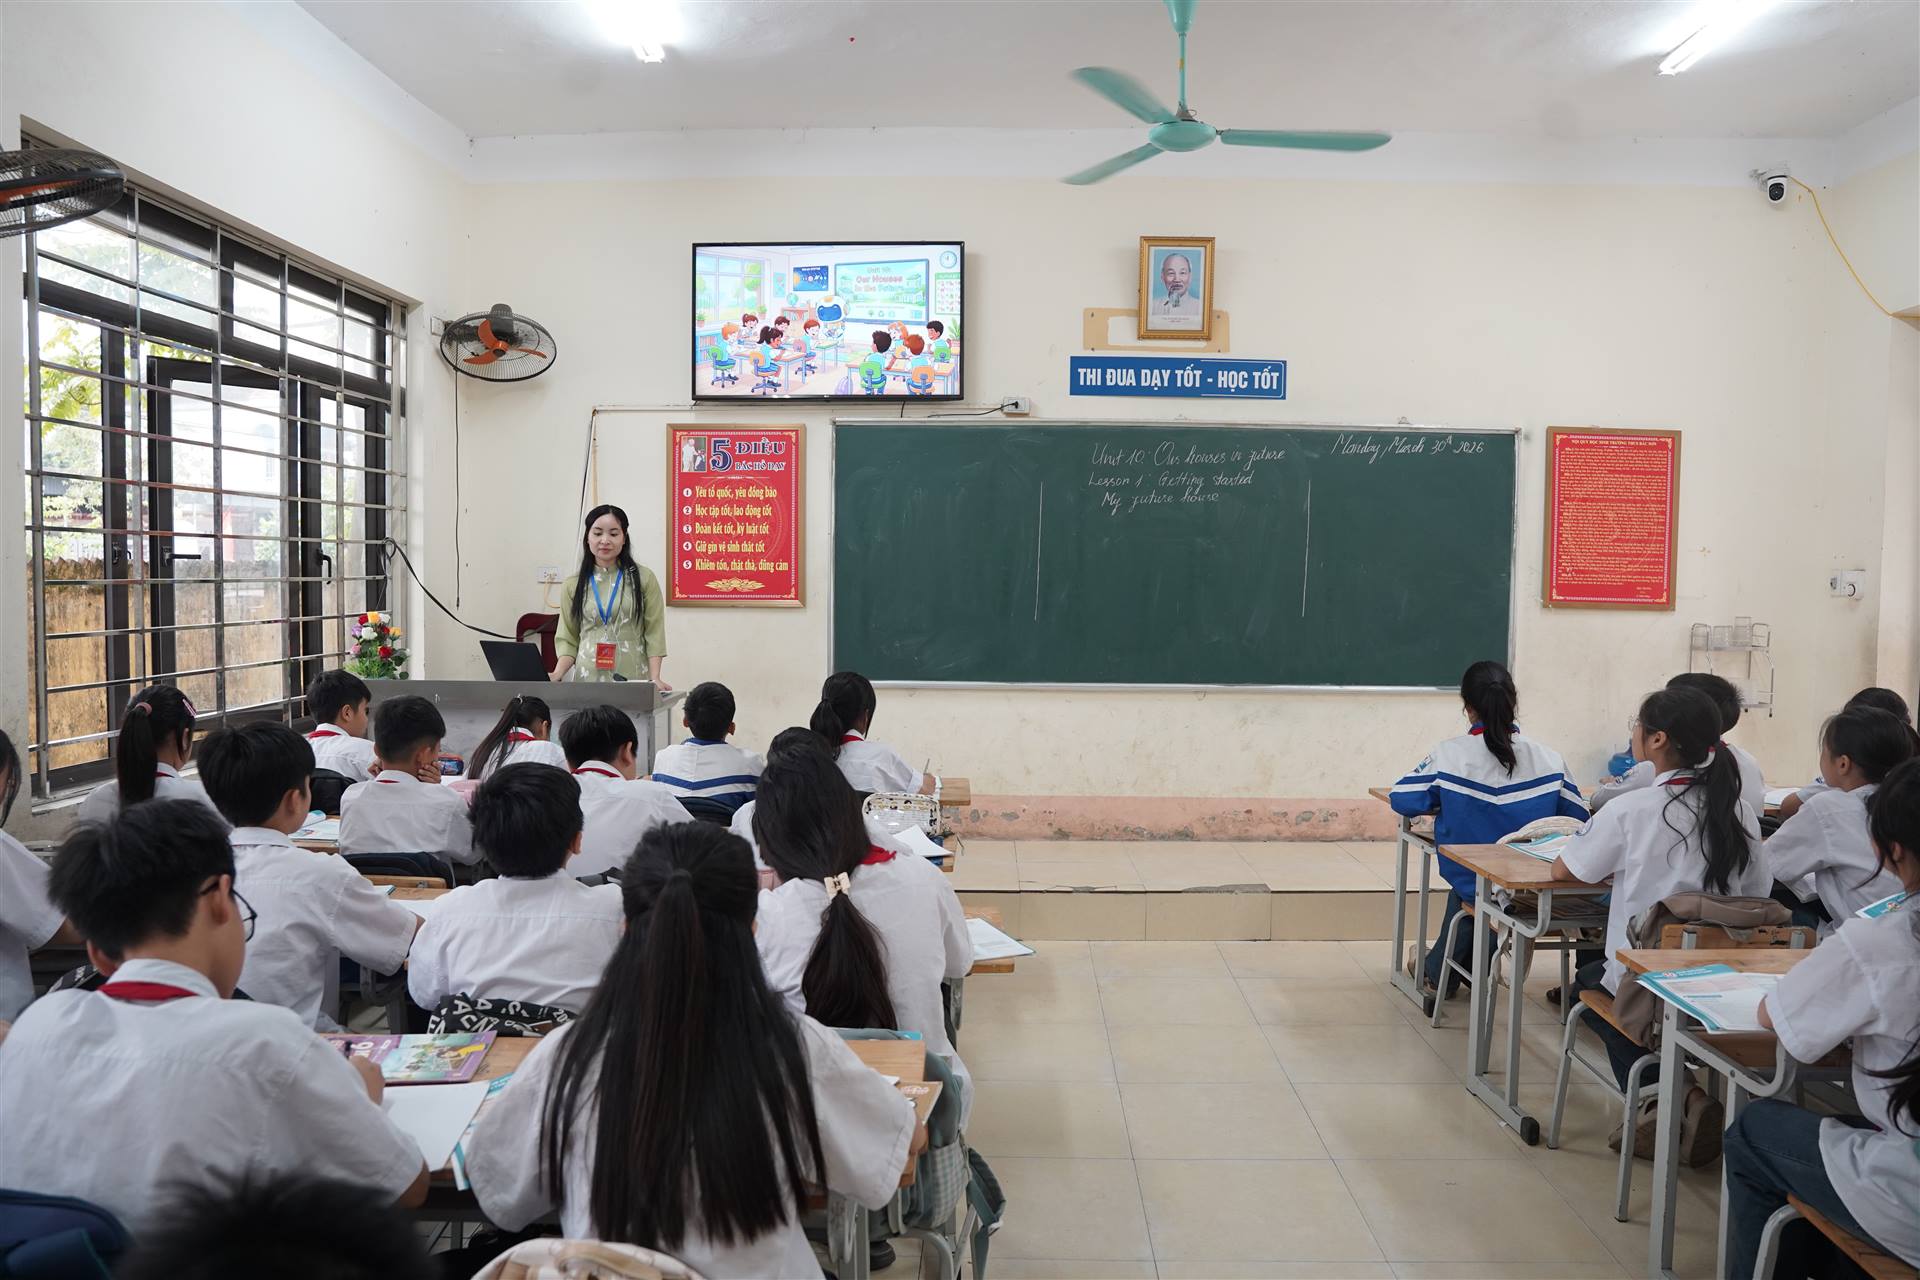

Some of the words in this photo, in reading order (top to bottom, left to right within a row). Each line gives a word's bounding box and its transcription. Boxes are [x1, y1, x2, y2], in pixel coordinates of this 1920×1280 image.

[1078, 368, 1101, 386] THI
[1106, 368, 1136, 386] ĐUA
[1141, 369, 1171, 390] DẠY
[1175, 364, 1202, 388] TỐT
[1217, 370, 1248, 392] HỌC
[1253, 365, 1279, 390] TỐT
[1388, 436, 1426, 454] March
[710, 438, 733, 472] 5
[735, 437, 786, 455] ĐIỀU
[1091, 442, 1123, 466] Unit
[1184, 445, 1226, 465] houses
[1231, 445, 1243, 461] in
[735, 461, 752, 471] BÁC
[753, 460, 766, 471] HỒ
[768, 461, 786, 472] DẠY
[1089, 472, 1130, 486] Lesson
[1159, 471, 1205, 495] Getting
[1213, 471, 1255, 486] started
[695, 486, 706, 498] Yêu
[708, 485, 715, 498] tổ
[716, 486, 733, 498] quốc,
[735, 488, 746, 499] yêu
[748, 486, 764, 499] đồng
[765, 487, 777, 498] bào
[1101, 492, 1123, 516] My
[1180, 487, 1220, 503] house
[695, 505, 708, 517] Học
[709, 507, 720, 517] tập
[721, 504, 732, 516] tốt,
[734, 505, 743, 516] lao
[745, 505, 761, 518] động
[762, 504, 772, 516] tốt
[695, 523, 711, 534] Đoàn
[712, 522, 722, 534] kết
[724, 522, 735, 534] tốt,
[746, 523, 756, 535] luật
[758, 522, 769, 534] tốt
[695, 541, 707, 552] Giữ
[708, 543, 717, 554] gìn
[719, 543, 726, 553] vệ
[727, 541, 740, 552] sinh
[741, 541, 754, 553] thật
[755, 540, 765, 552] tốt
[695, 560, 715, 570] Khiêm
[716, 559, 729, 571] tốn,
[731, 560, 743, 572] thật
[745, 560, 757, 571] thà,
[759, 560, 774, 573] dũng
[776, 560, 789, 570] cảm
